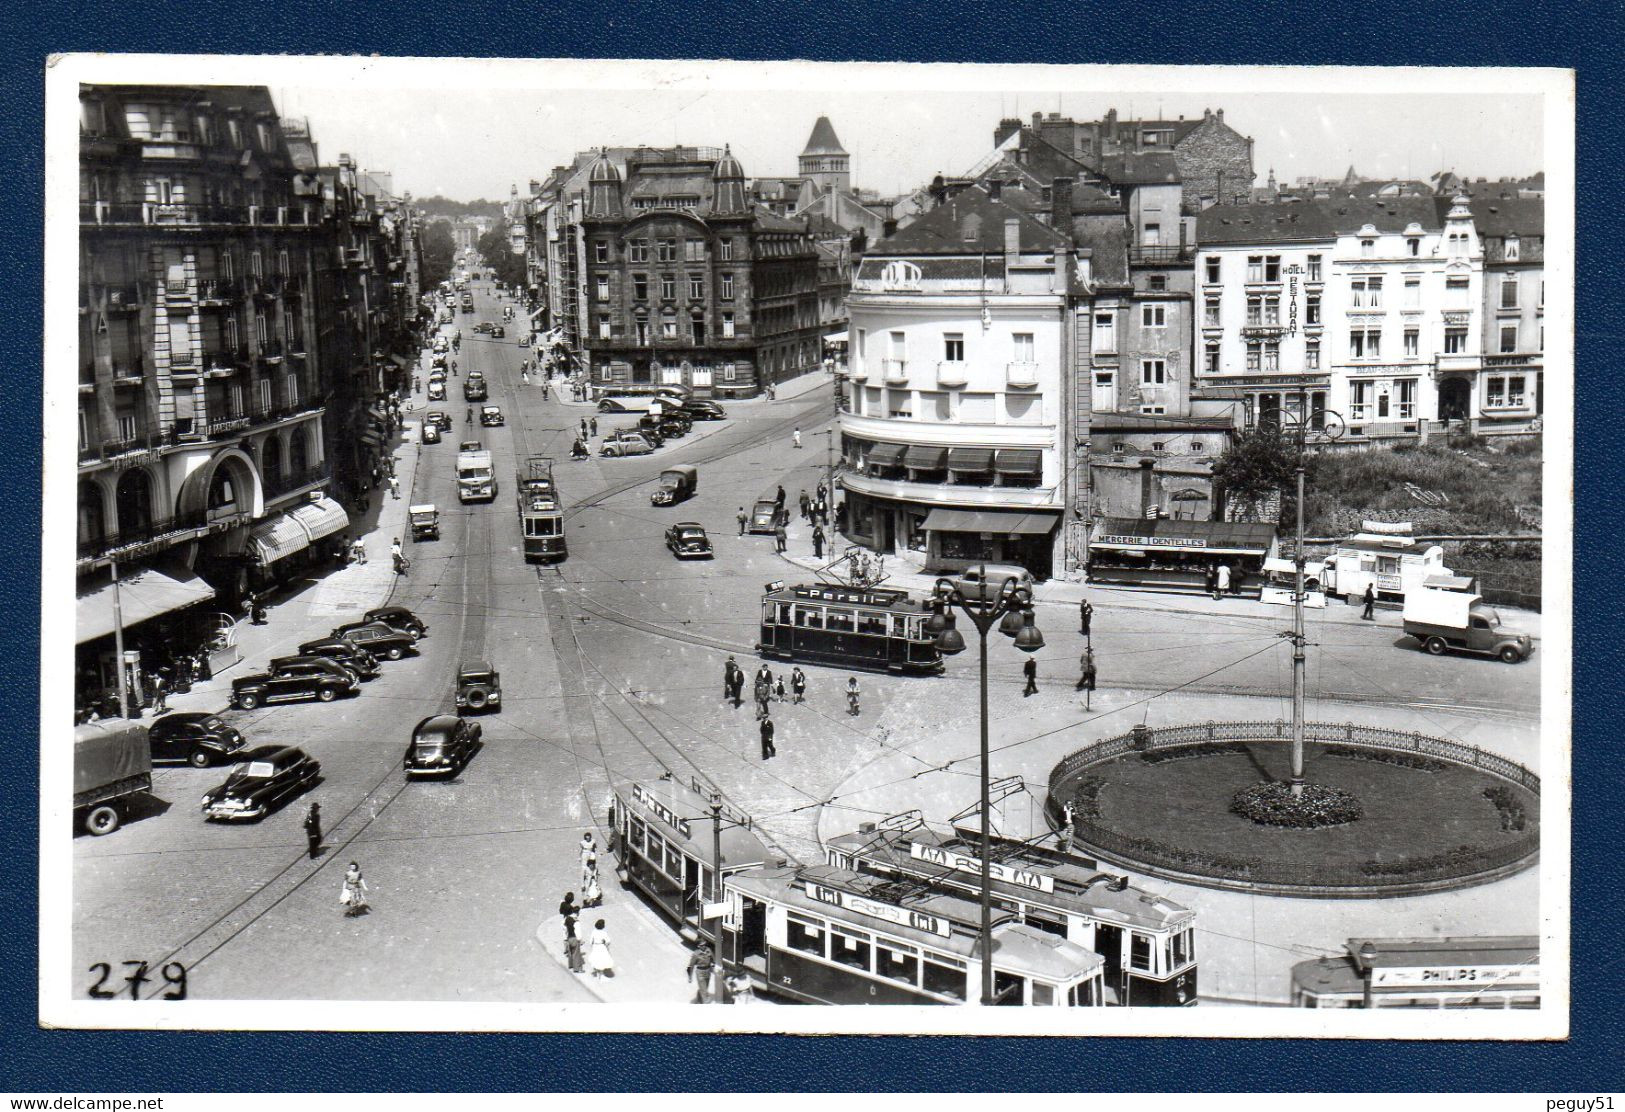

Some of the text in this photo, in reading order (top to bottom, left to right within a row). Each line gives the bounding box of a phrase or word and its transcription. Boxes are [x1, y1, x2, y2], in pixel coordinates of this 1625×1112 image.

[1282, 264, 1306, 275] HOTEL
[1289, 276, 1298, 338] RESTAURANT
[1098, 536, 1143, 544] MERCERIE
[1152, 538, 1204, 547] DENTELLES
[922, 848, 1040, 890] ATA ATA
[88, 960, 187, 1001] 279
[1423, 969, 1477, 981] PHILIPS
[1176, 975, 1186, 988] 25
